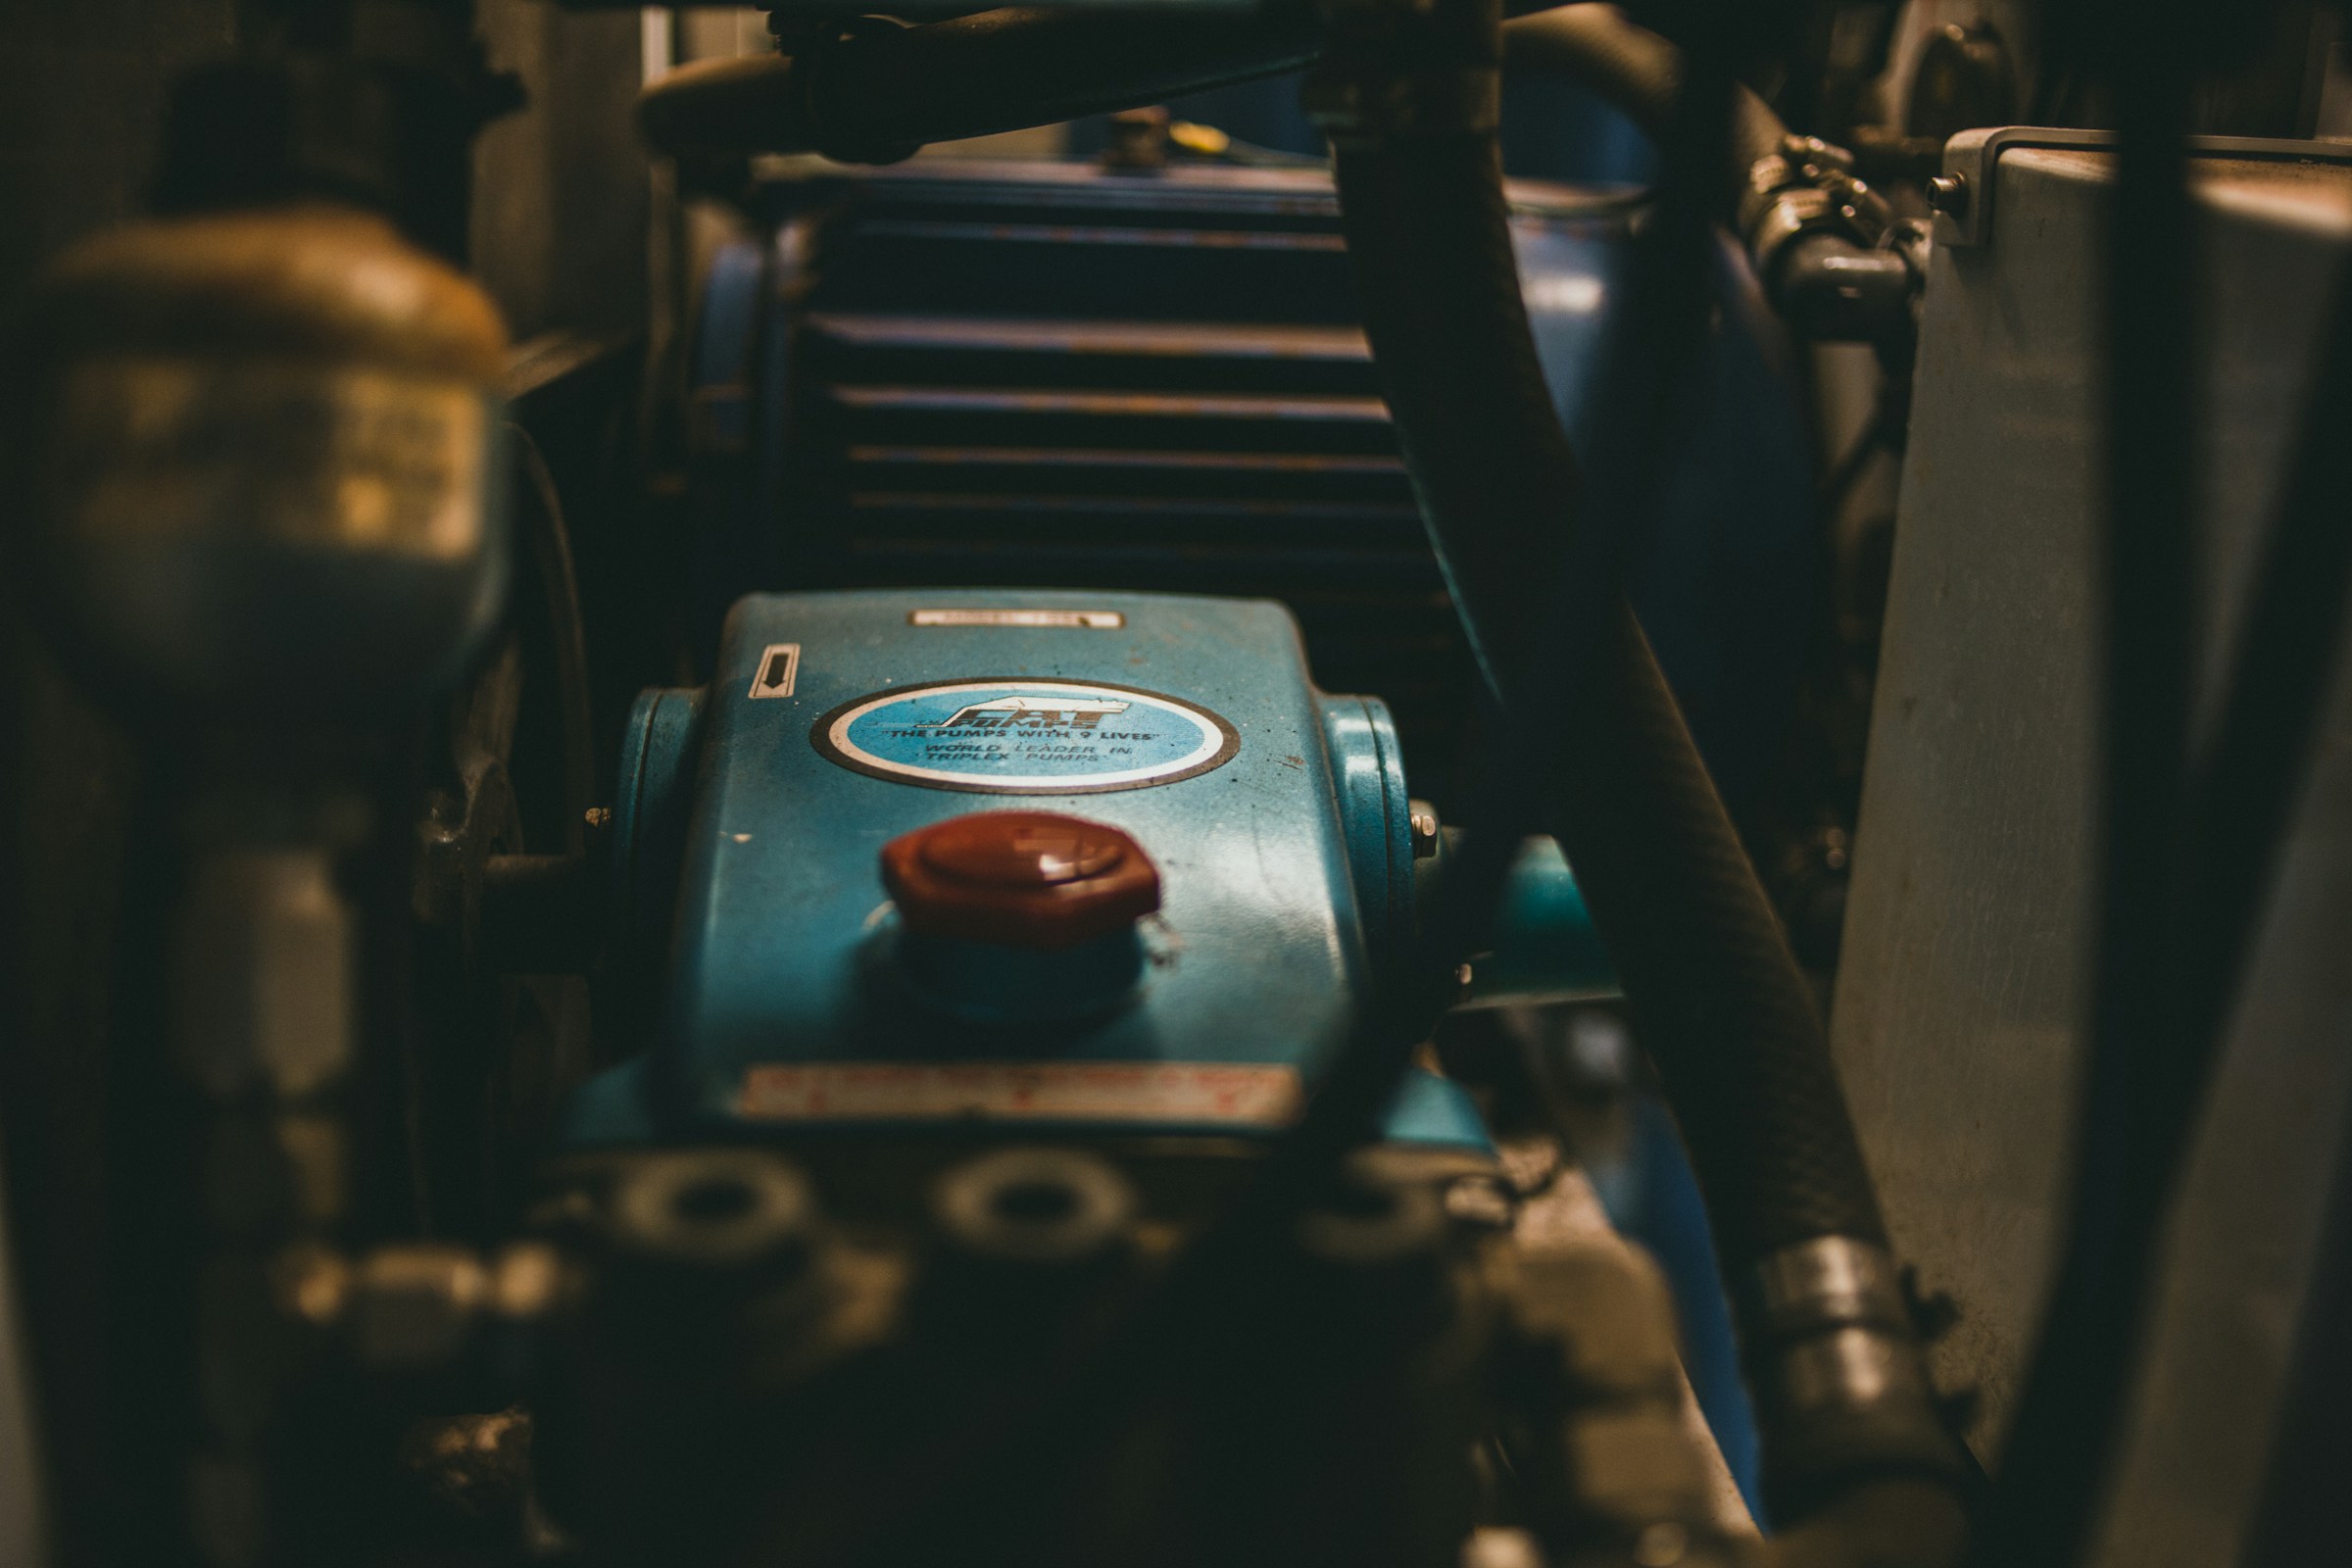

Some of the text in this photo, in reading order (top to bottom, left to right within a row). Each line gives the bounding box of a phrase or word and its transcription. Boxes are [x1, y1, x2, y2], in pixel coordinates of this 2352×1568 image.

[956, 708, 1122, 720] CAT
[946, 718, 1099, 729] PUMPS
[1015, 745, 1096, 754] LEADER
